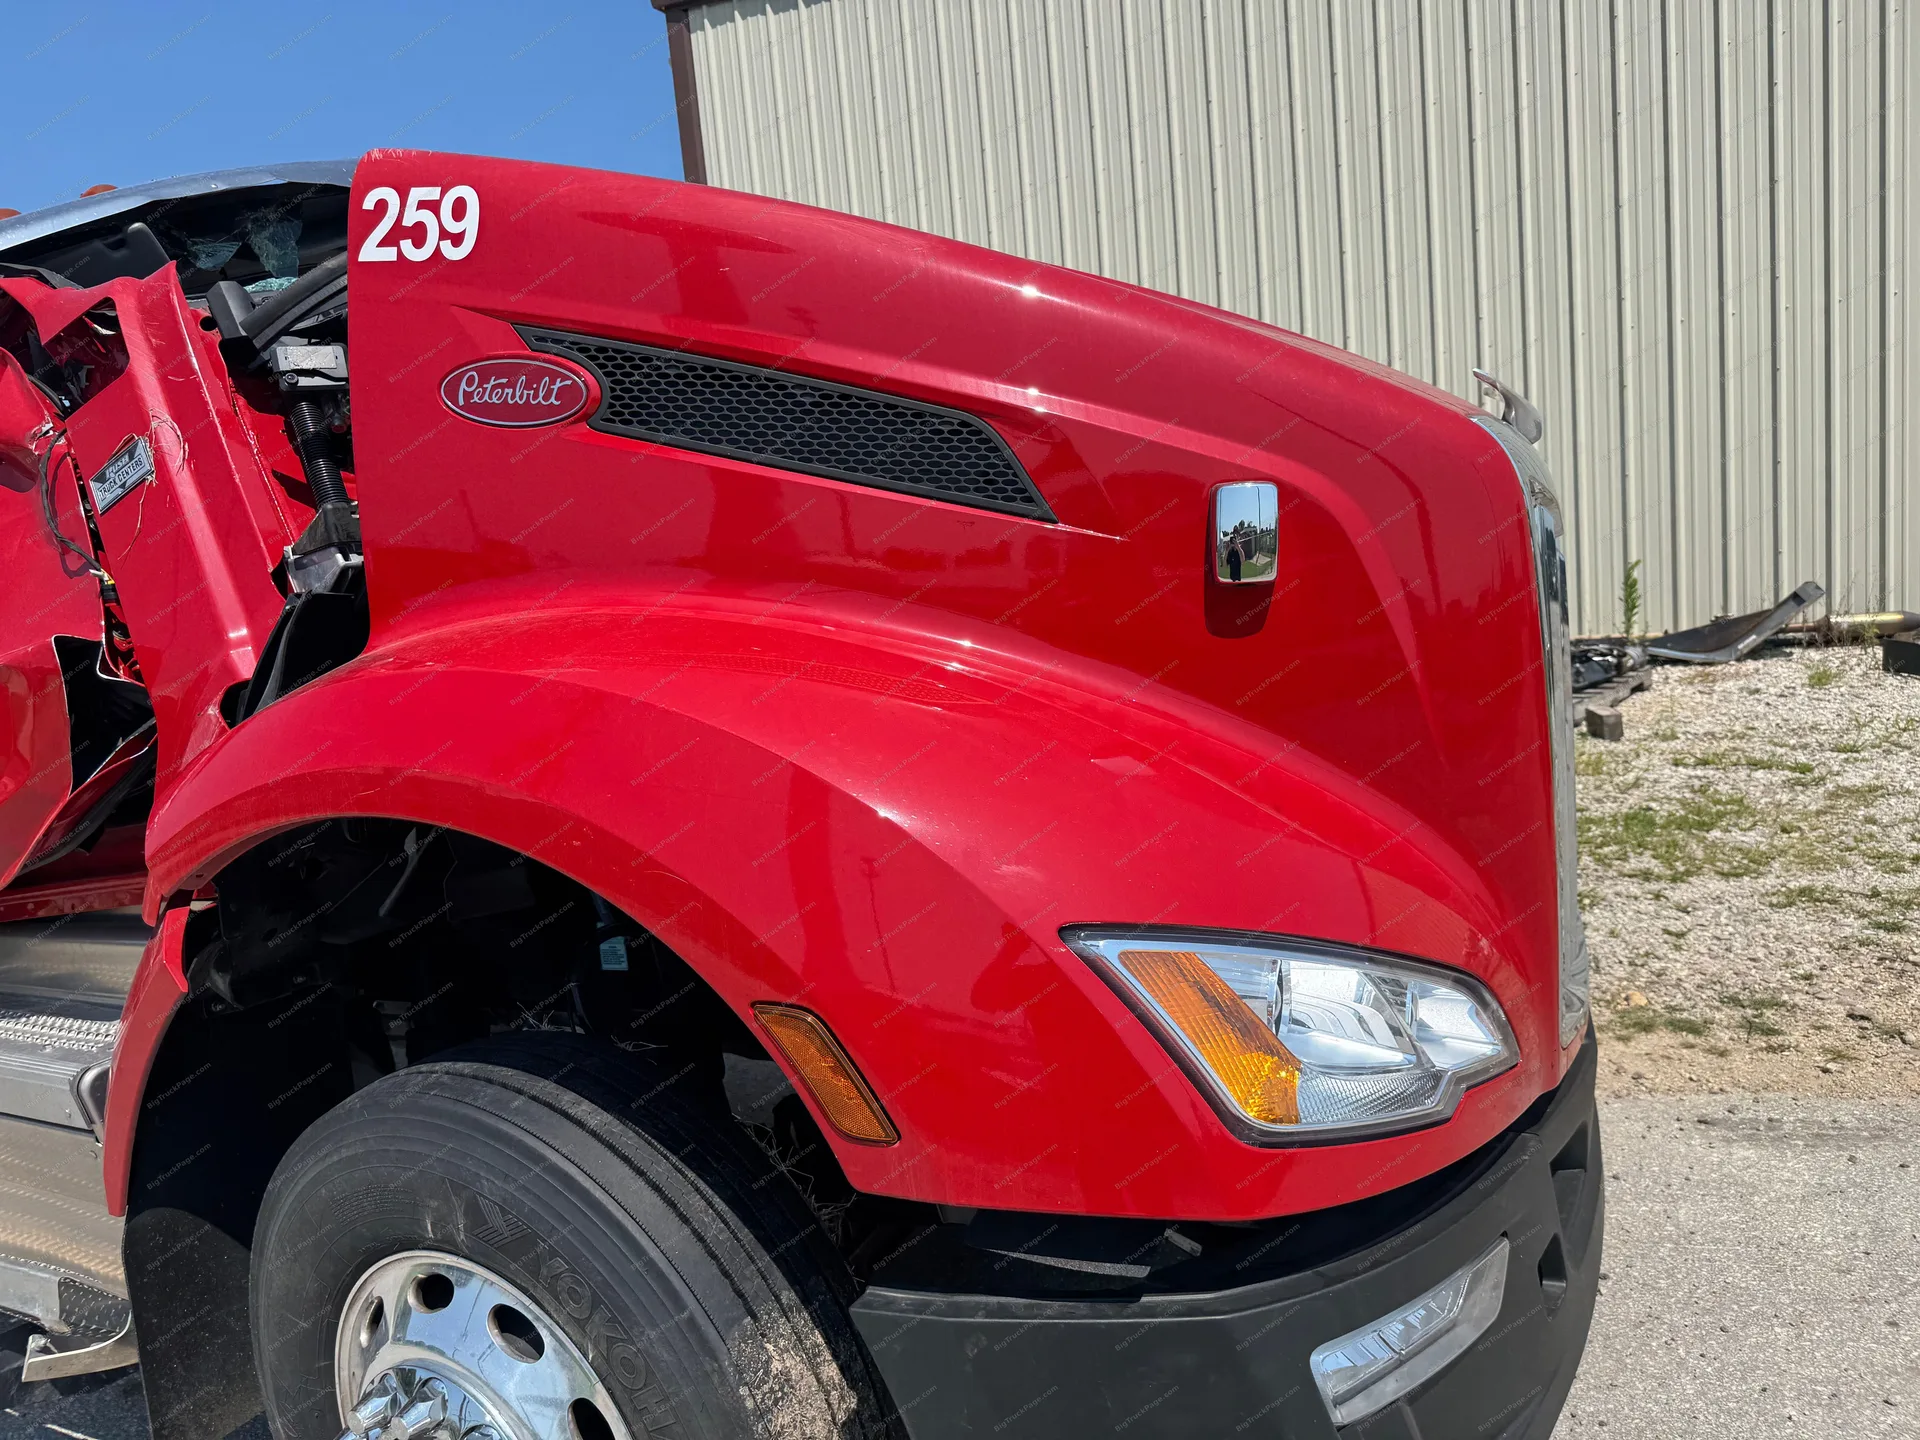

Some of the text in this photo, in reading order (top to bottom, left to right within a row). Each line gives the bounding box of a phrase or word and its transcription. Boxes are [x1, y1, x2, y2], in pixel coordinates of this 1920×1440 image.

[358, 185, 480, 262] 259
[458, 371, 573, 406] Peterbilt
[99, 457, 143, 498] TRUCK CENTERS
[536, 1238, 677, 1440] YOKOH
